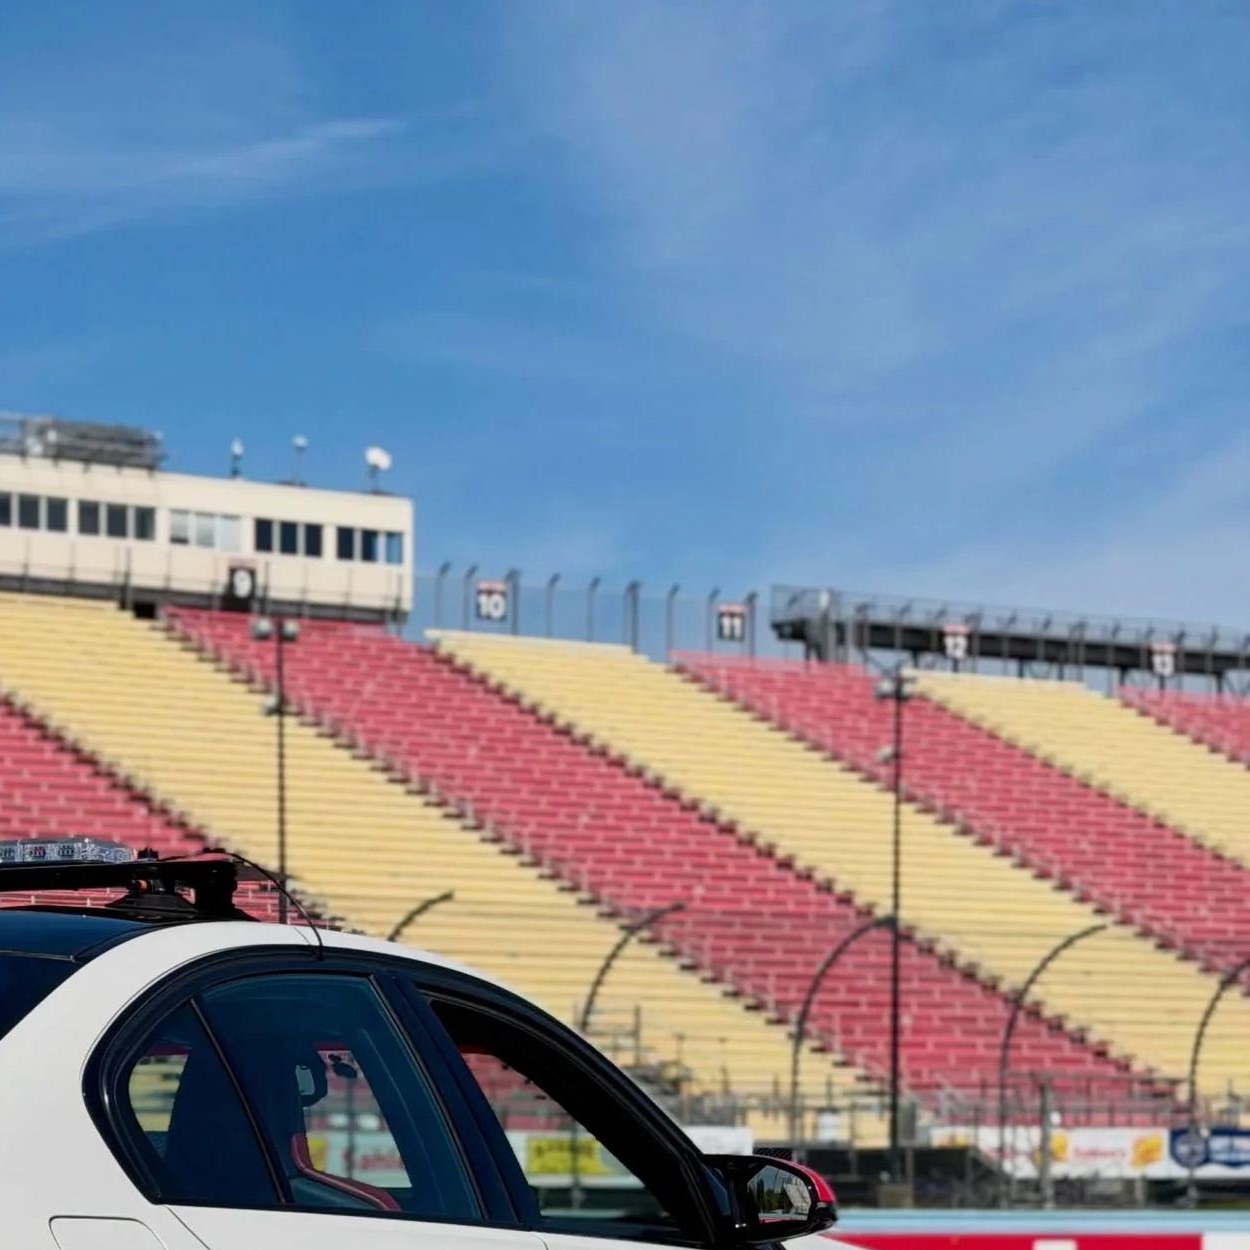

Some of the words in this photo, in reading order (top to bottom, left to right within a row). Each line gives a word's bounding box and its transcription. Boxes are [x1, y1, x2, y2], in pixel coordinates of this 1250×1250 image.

[232, 568, 255, 601] 9
[477, 591, 506, 620] 10
[718, 610, 744, 638] 11
[944, 635, 968, 659] 12
